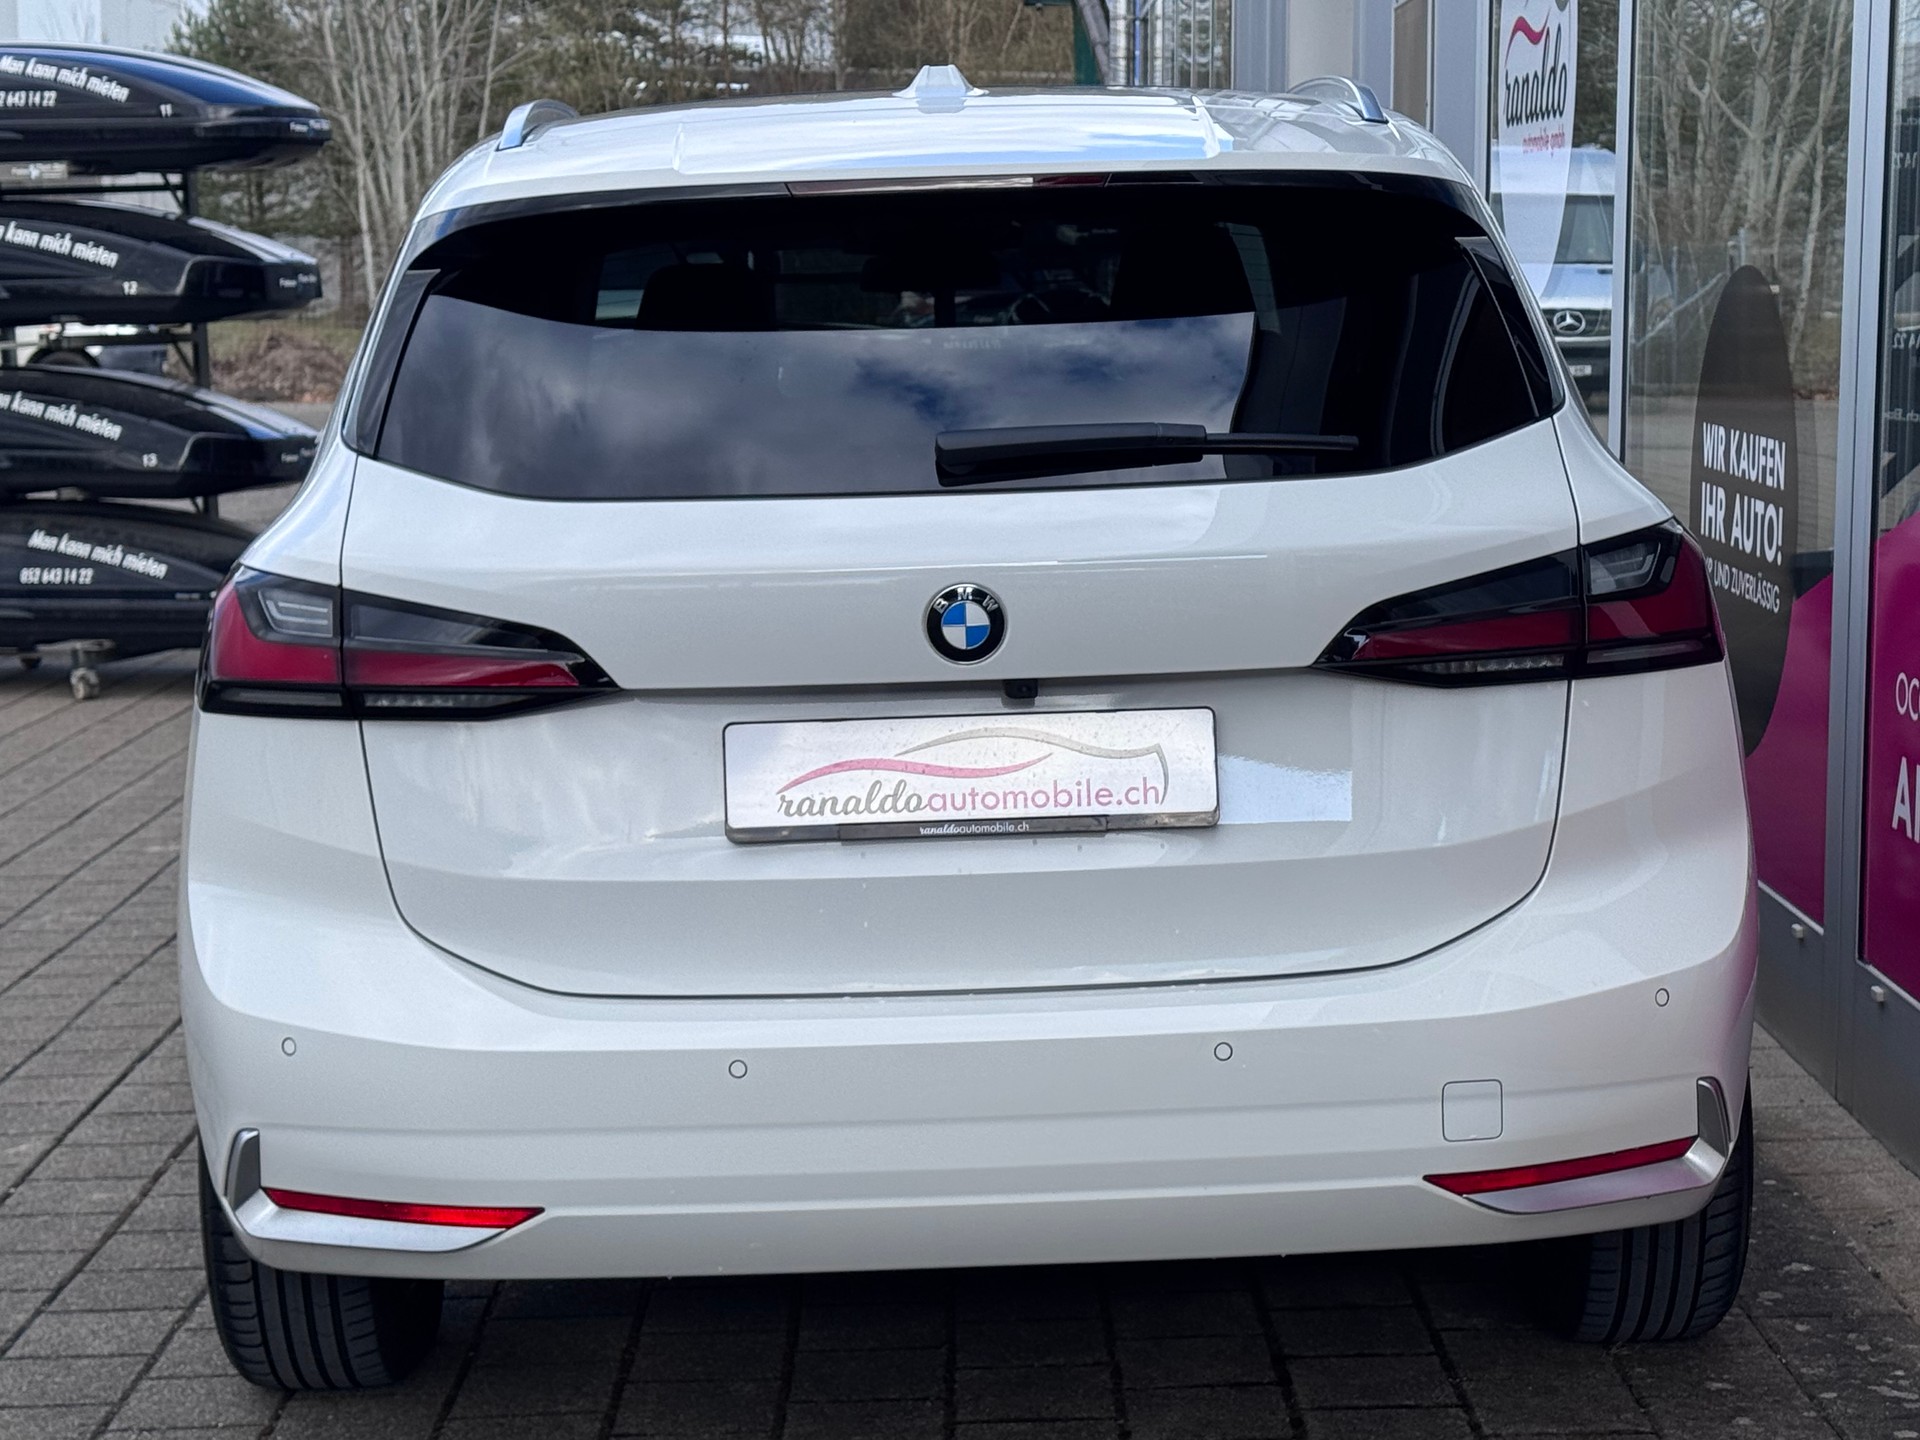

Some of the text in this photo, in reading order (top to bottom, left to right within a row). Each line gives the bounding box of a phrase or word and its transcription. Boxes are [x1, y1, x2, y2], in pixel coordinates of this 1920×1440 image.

[25, 57, 58, 81] kann
[57, 67, 88, 89] mich
[86, 75, 130, 103] mieten
[28, 91, 41, 107] 14
[42, 90, 57, 107] 22
[1504, 23, 1568, 128] ranaldo
[5, 221, 39, 248] kann
[39, 233, 72, 255] mich
[72, 241, 119, 269] mieten
[11, 391, 45, 418] kann
[44, 404, 77, 427] mich
[76, 413, 123, 441] mieten
[1703, 422, 1786, 491] WIR KAUFEN
[1701, 481, 1783, 566] IHR AUTO!
[28, 529, 168, 580] Man kann mich mieten
[933, 586, 999, 614] BMW
[1714, 559, 1730, 590] UND
[1731, 567, 1780, 614] ZUVERLÄSSIG
[1896, 672, 1920, 721] OC
[777, 776, 1160, 817] ranaldoautomobile.ch
[919, 821, 1030, 836] ranaldoautomobile.ch
